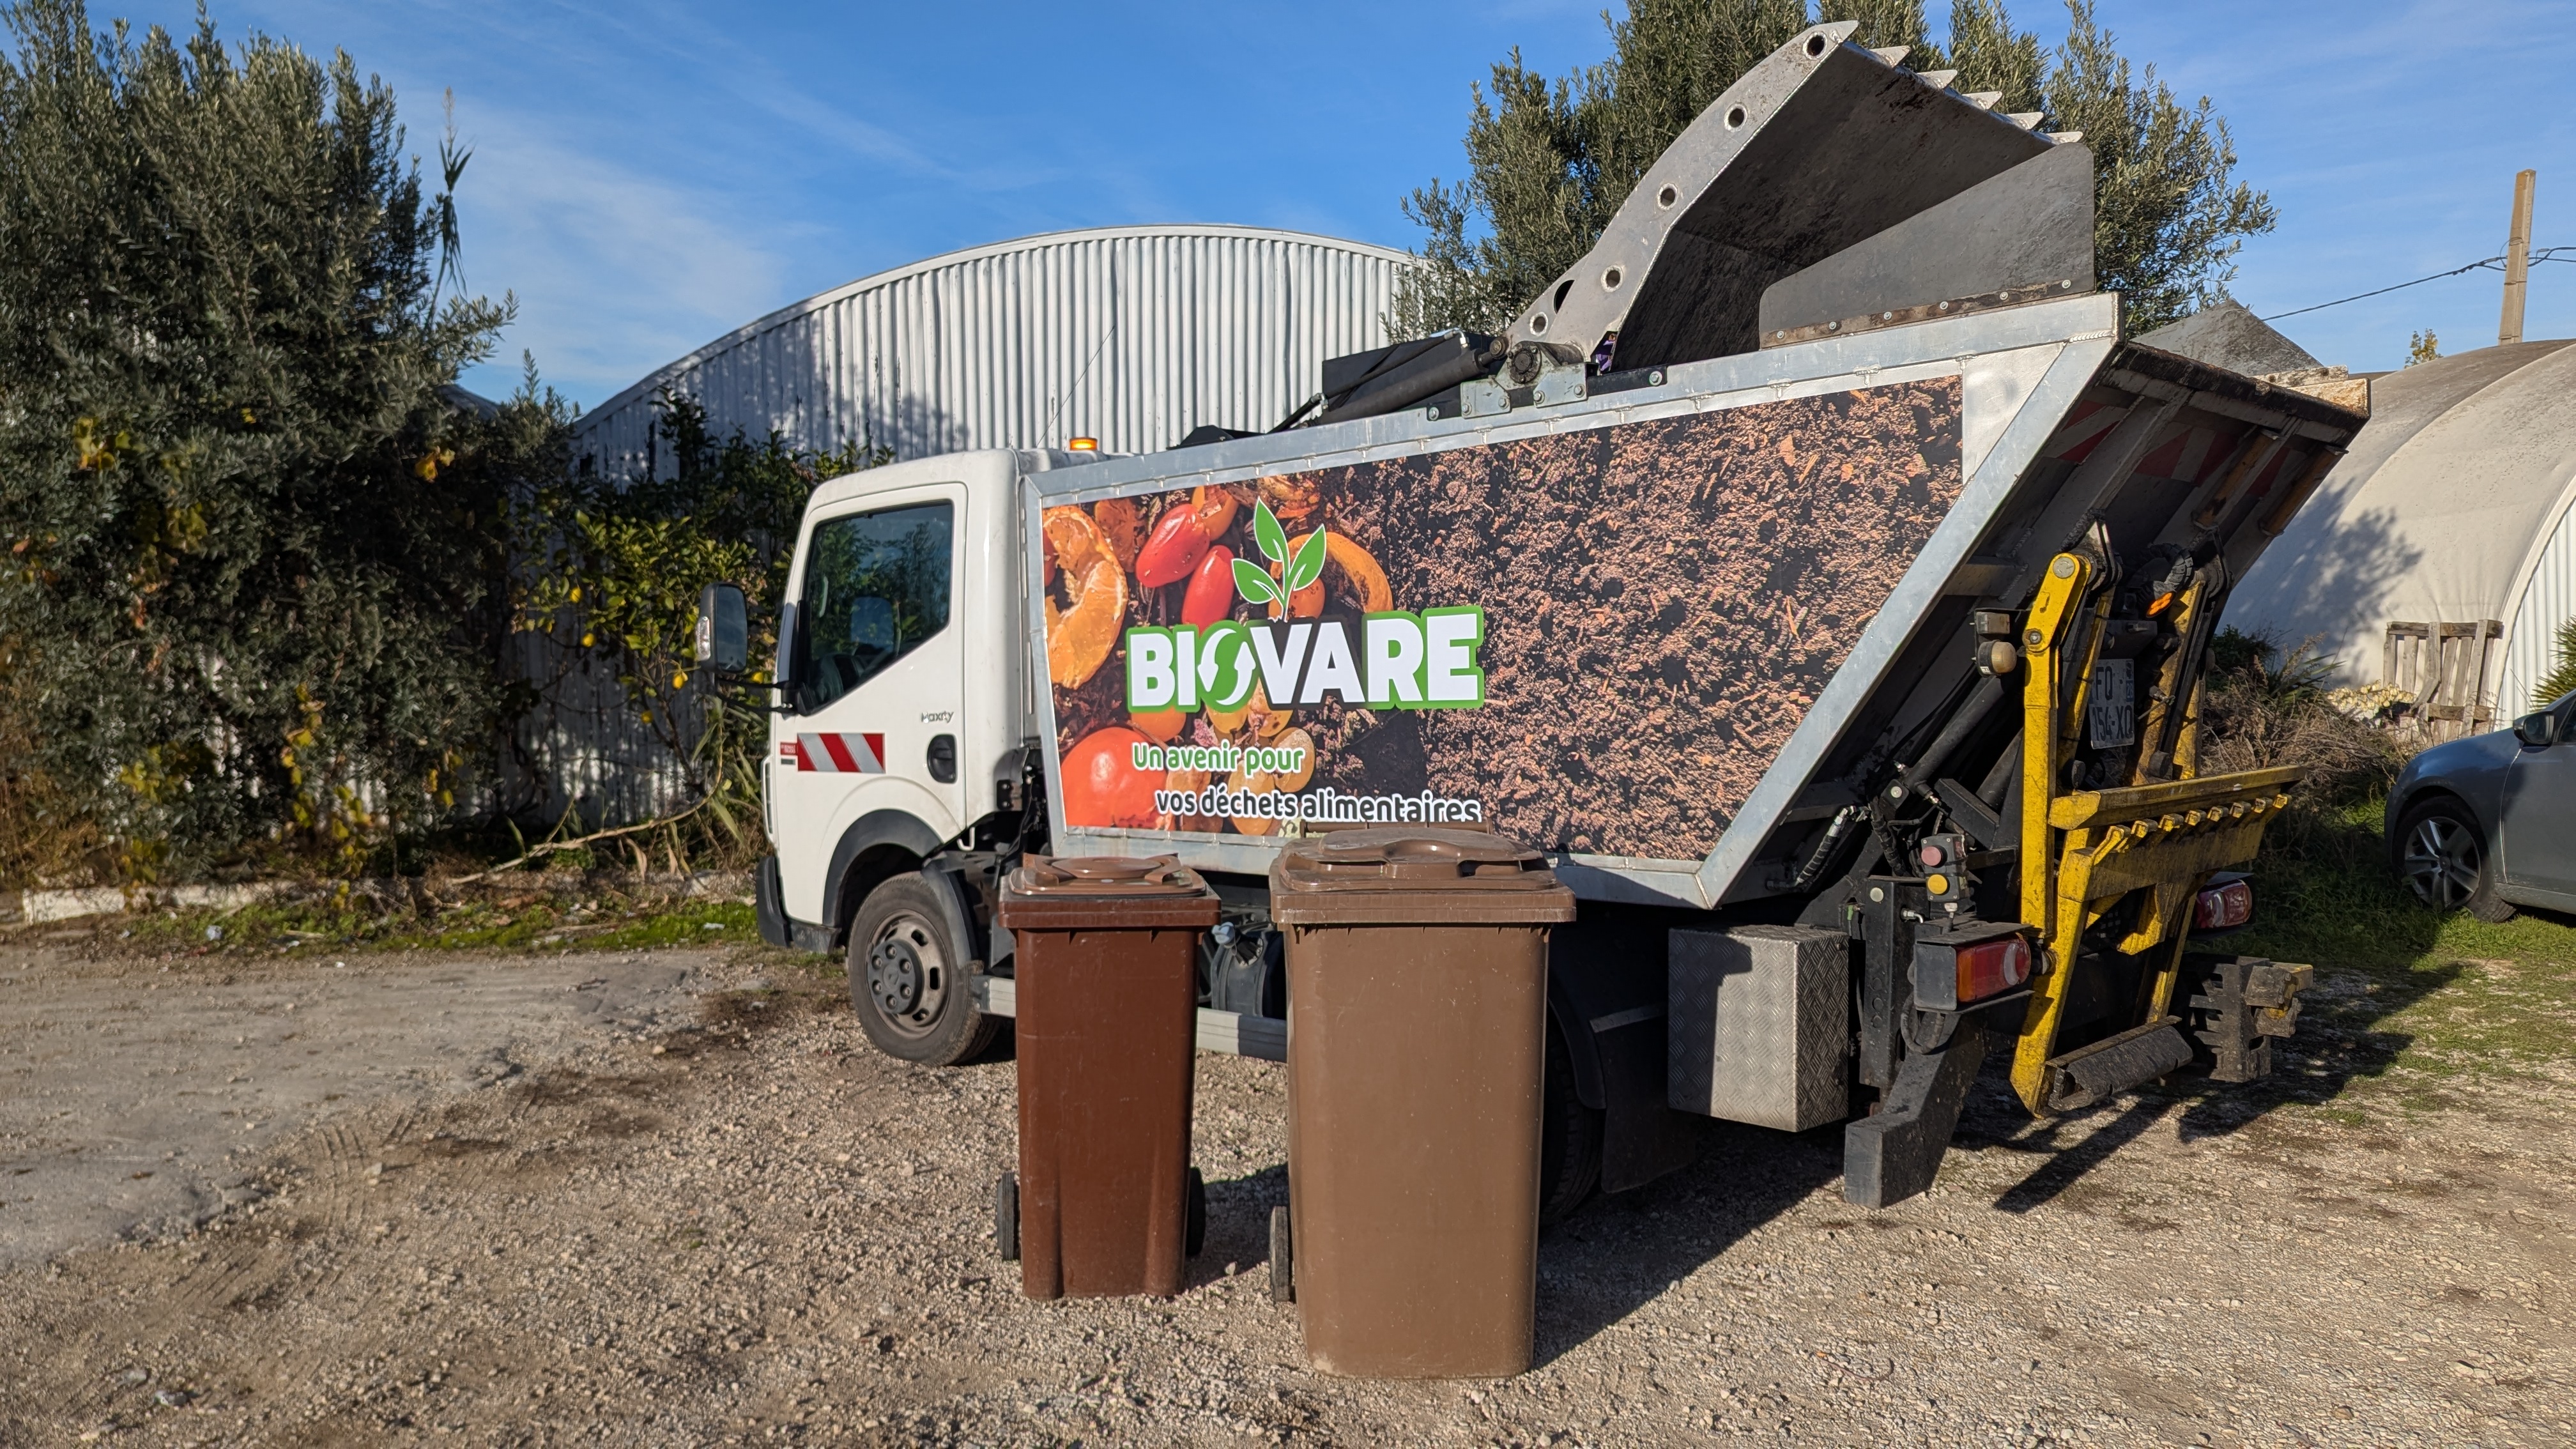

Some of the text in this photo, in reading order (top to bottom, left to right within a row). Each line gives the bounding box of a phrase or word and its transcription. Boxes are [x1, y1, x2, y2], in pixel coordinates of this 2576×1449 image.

[1130, 613, 1479, 707] BIOVARE
[1133, 742, 1303, 776] Un avenir pour
[1156, 785, 1480, 822] vos déchets alimentaires
